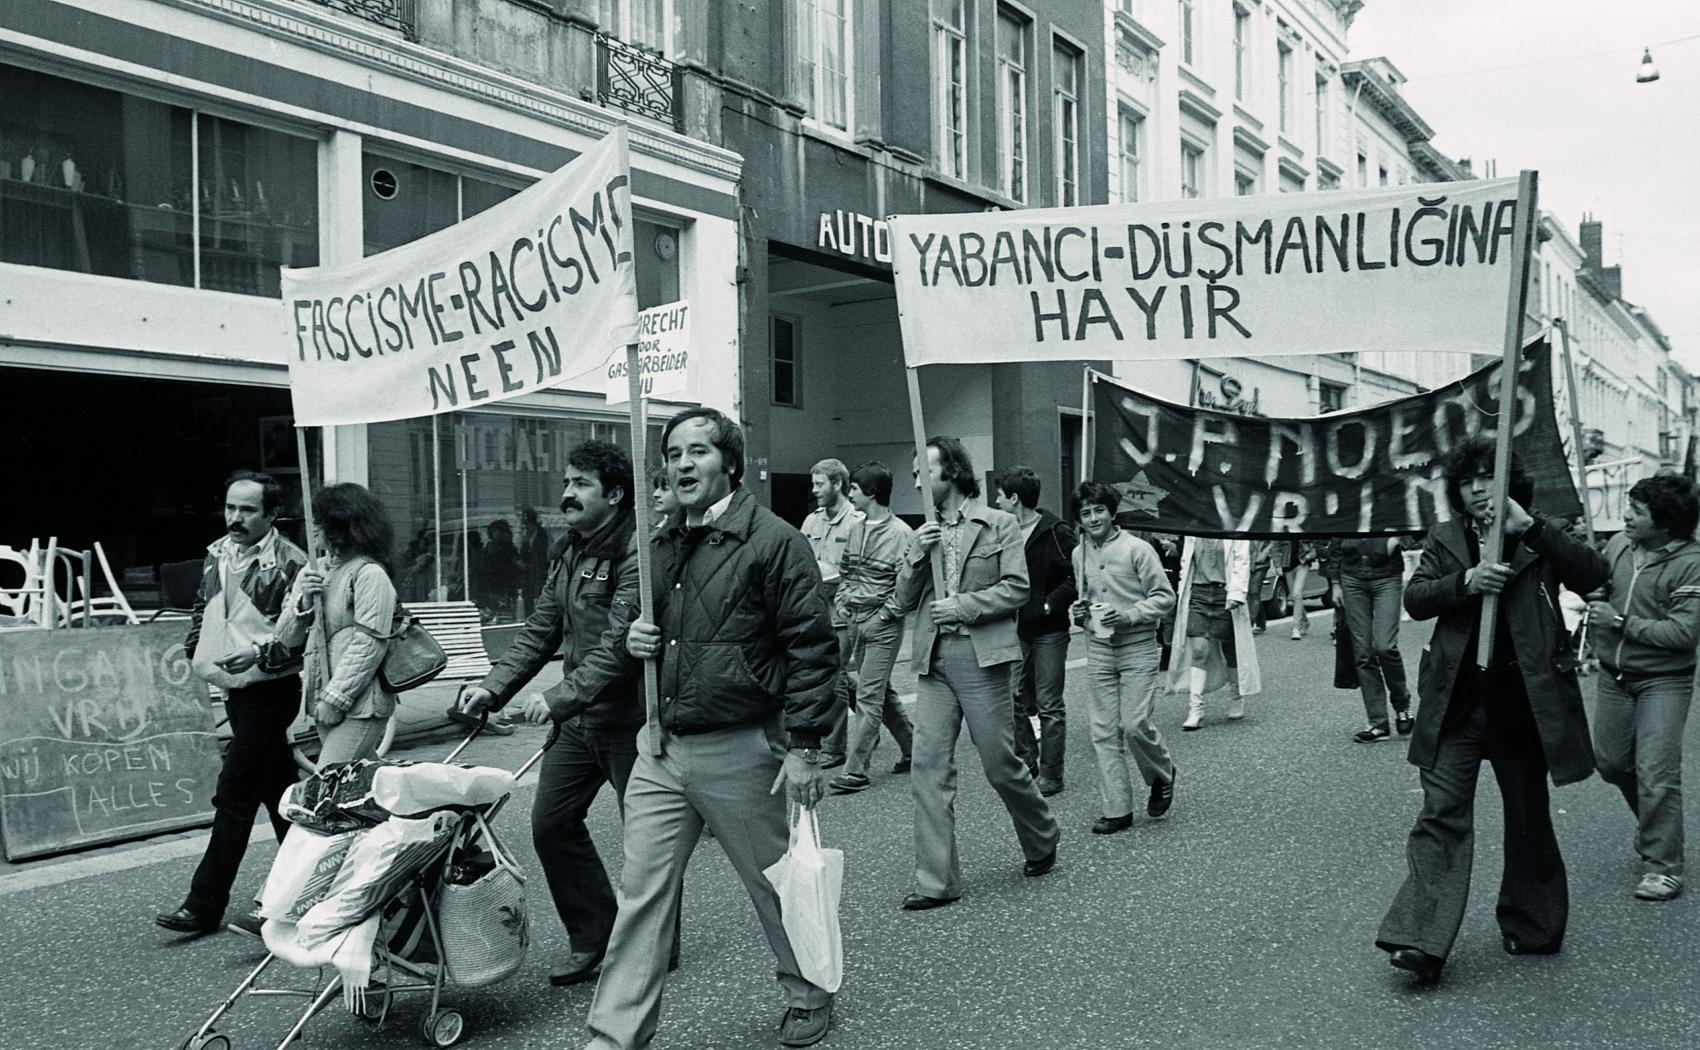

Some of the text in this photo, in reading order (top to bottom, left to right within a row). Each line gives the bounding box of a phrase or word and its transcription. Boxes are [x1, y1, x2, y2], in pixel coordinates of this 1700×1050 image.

[818, 209, 892, 264] AUTO
[639, 306, 688, 335] RECHT
[1029, 283, 1253, 342] HAYIR
[427, 326, 562, 411] NEEN
[62, 743, 173, 776] KOPEN
[88, 778, 196, 816] ALLES
